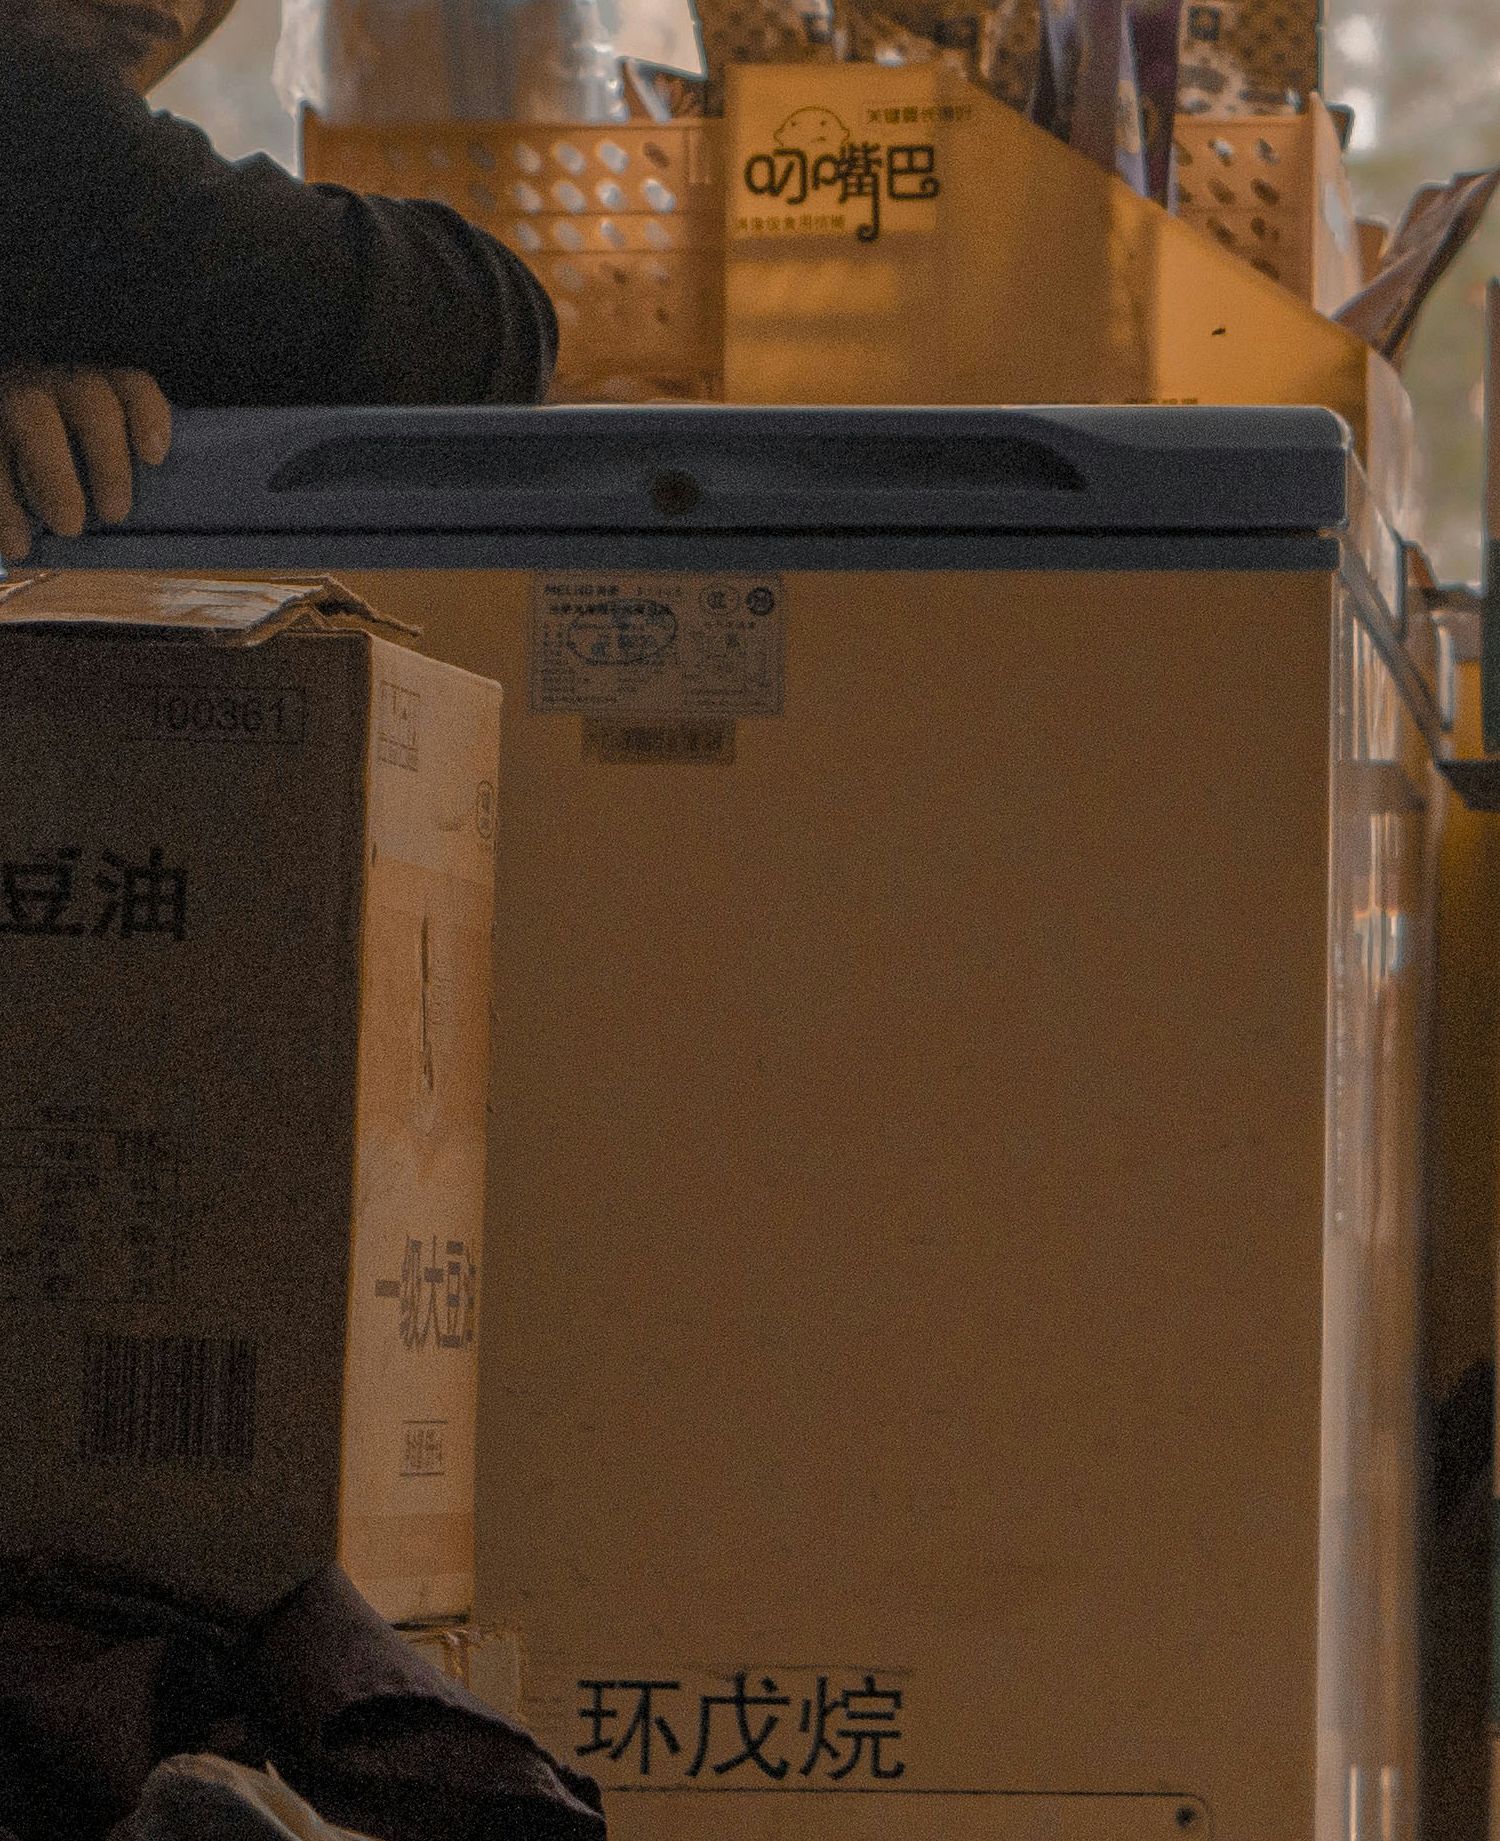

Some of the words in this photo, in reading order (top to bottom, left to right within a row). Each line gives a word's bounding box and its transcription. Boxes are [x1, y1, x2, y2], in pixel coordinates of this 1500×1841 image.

[153, 693, 288, 735] 100361
[573, 1670, 907, 1782] 环戊烷
